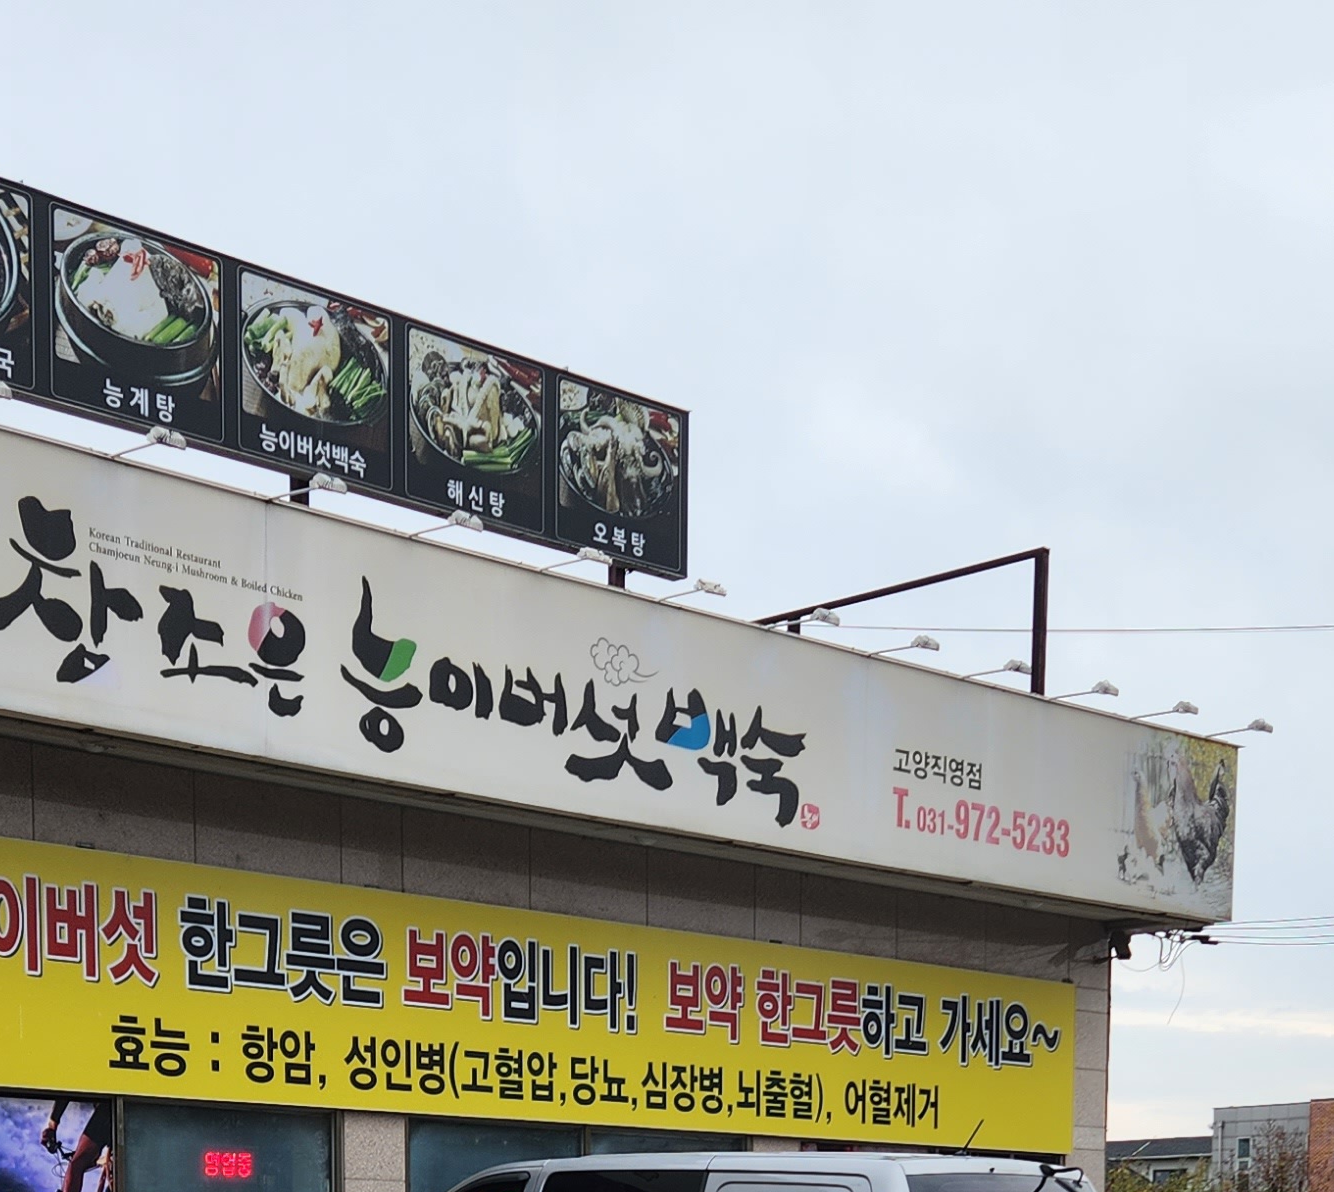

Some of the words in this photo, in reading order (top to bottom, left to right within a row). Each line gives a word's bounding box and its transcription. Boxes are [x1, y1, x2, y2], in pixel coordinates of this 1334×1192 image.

[103, 378, 175, 422] 능계탕
[259, 423, 366, 478] 능이버섯백숙
[447, 479, 505, 518] 해신탕
[89, 527, 121, 544] Korean
[124, 536, 172, 556] Traditional
[177, 550, 221, 569] Restaurant
[593, 523, 645, 556] 오복탕
[89, 542, 140, 563] Chamjoeun
[144, 555, 179, 573] Neung-i
[182, 564, 227, 584] Mushroom
[231, 576, 238, 586] &
[241, 578, 267, 593] Boiled
[270, 586, 303, 601] Chicken
[341, 575, 807, 828] 능이버섯백숙
[893, 749, 983, 790] 고양직영점
[917, 800, 1070, 858] 031-972-5233
[178, 893, 386, 1008] 한그릇은
[401, 926, 638, 1035] 보약입니다!
[664, 958, 744, 1044] 보약
[754, 967, 929, 1060] 한그릇하고
[939, 994, 1061, 1069] 가세요~
[109, 1015, 190, 1077] 효능
[240, 1026, 327, 1090] 항암,
[844, 1079, 940, 1129] 어혈제거
[205, 1152, 251, 1178] 영업중
